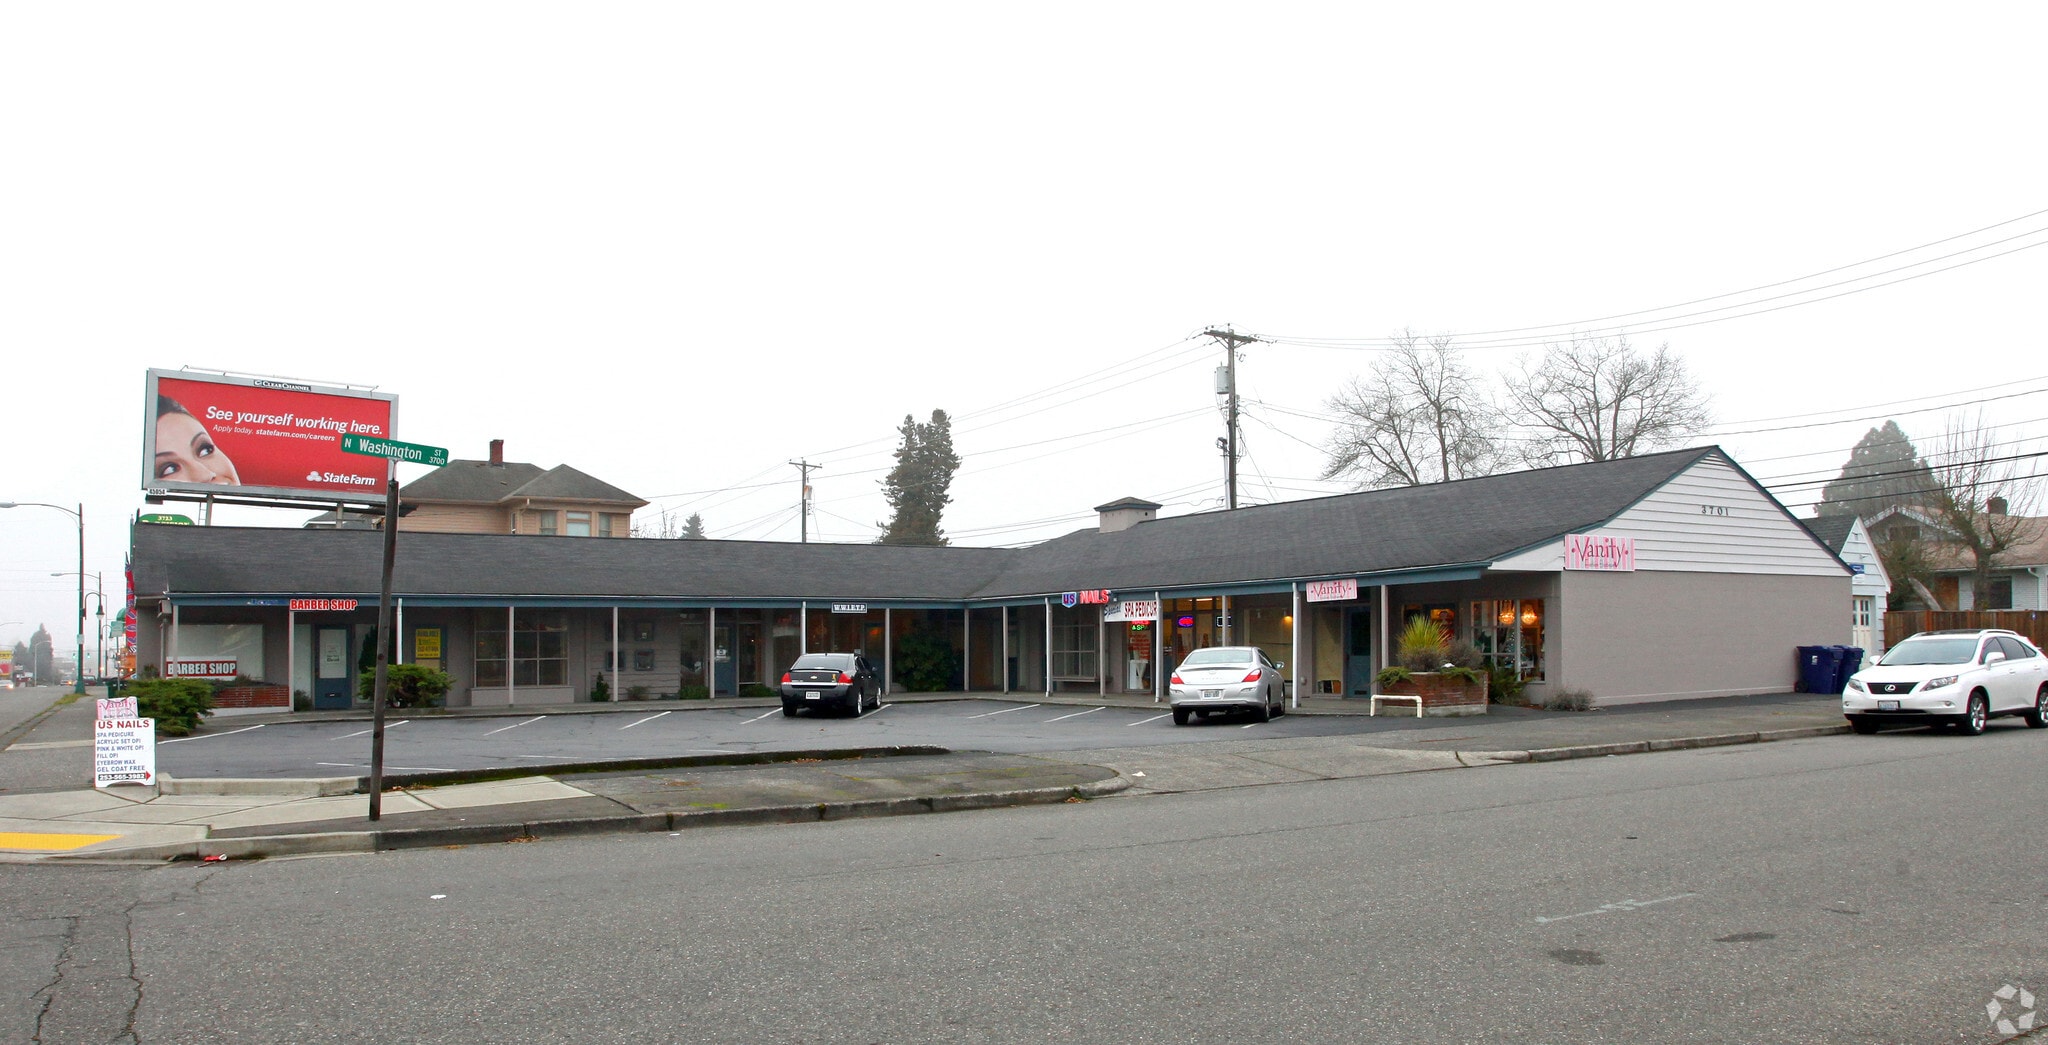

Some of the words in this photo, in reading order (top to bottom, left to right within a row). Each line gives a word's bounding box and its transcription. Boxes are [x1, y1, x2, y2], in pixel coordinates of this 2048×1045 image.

[205, 405, 233, 420] See
[235, 411, 294, 427] yourself
[295, 417, 347, 434] working
[350, 419, 383, 435] here.
[212, 424, 232, 433] Apply
[234, 426, 254, 435] today.
[255, 428, 336, 441] statefarm.com/careers
[344, 438, 352, 448] N
[359, 438, 422, 460] Washington
[434, 449, 442, 457] ST
[428, 456, 445, 465] 3700
[1701, 505, 1729, 516] 3701
[1575, 537, 1626, 568] Vanity
[1063, 593, 1075, 604] US
[1080, 589, 1110, 604] NAILS
[1313, 581, 1350, 599] Vanity
[290, 599, 329, 611] BARBER
[331, 599, 358, 611] SHOP
[1124, 602, 1134, 618] SPA
[209, 662, 236, 675] SHOP
[101, 698, 134, 711] Vanity
[98, 721, 113, 729] US
[117, 720, 150, 729] NAILS
